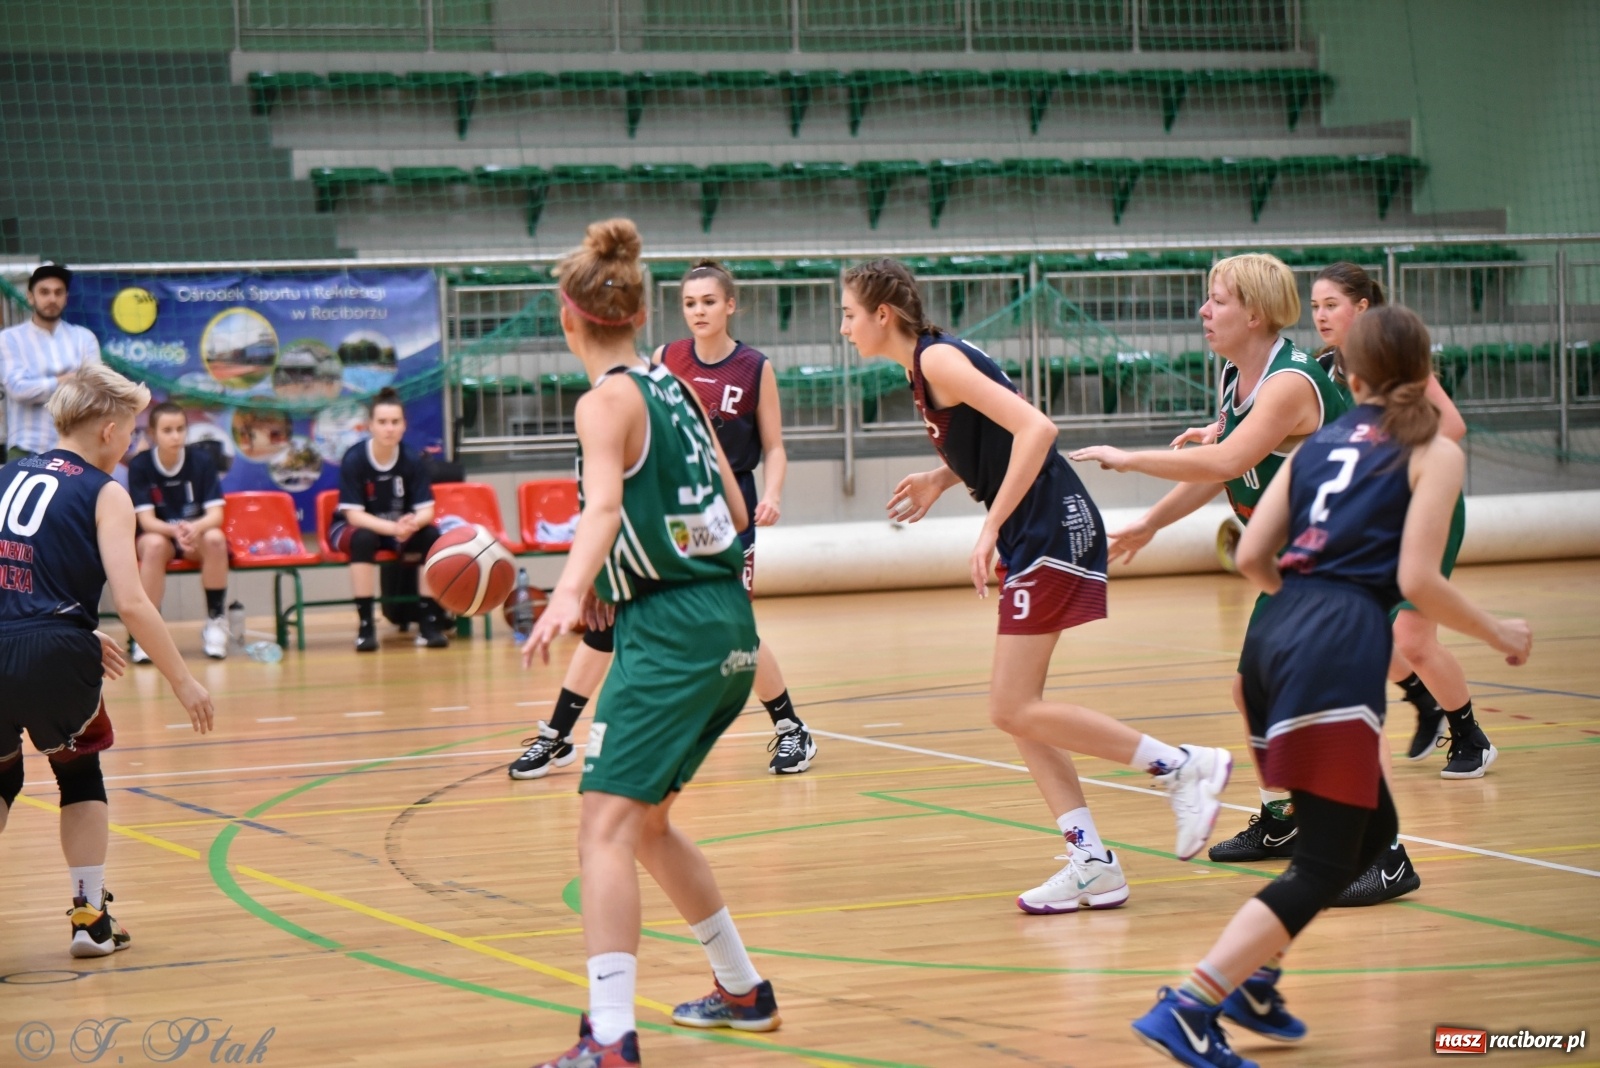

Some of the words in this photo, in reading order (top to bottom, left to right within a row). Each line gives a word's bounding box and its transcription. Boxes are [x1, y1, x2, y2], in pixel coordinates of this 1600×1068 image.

[249, 285, 301, 304] Sportu
[291, 308, 306, 320] w
[311, 306, 388, 320] Raciborzu
[720, 384, 744, 415] 12
[1309, 447, 1360, 525] 2
[0, 470, 59, 537] 10
[1012, 589, 1030, 620] 9
